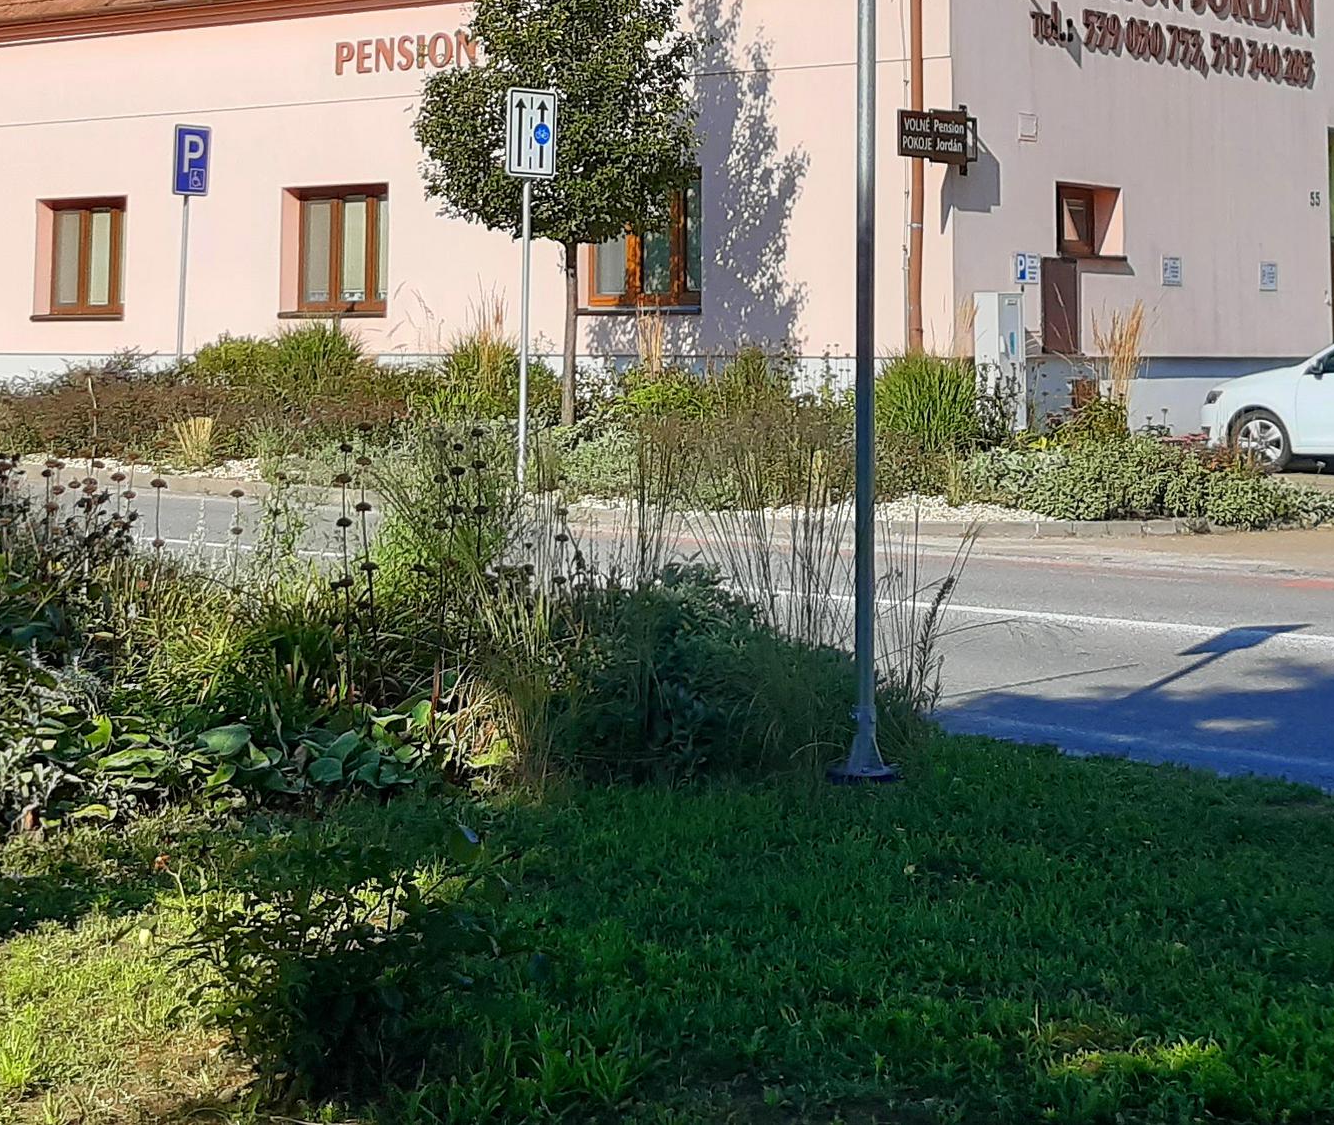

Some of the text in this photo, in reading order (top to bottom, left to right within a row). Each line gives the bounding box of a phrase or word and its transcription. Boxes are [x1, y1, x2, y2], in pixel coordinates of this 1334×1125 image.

[335, 28, 480, 76] PENSION
[903, 117, 930, 132] VOLNÉ
[933, 119, 965, 134] Pension
[902, 136, 932, 150] POKOJE
[935, 138, 963, 152] Jordán
[183, 134, 205, 173] P
[1309, 191, 1321, 207] 55
[1017, 255, 1025, 278] P
